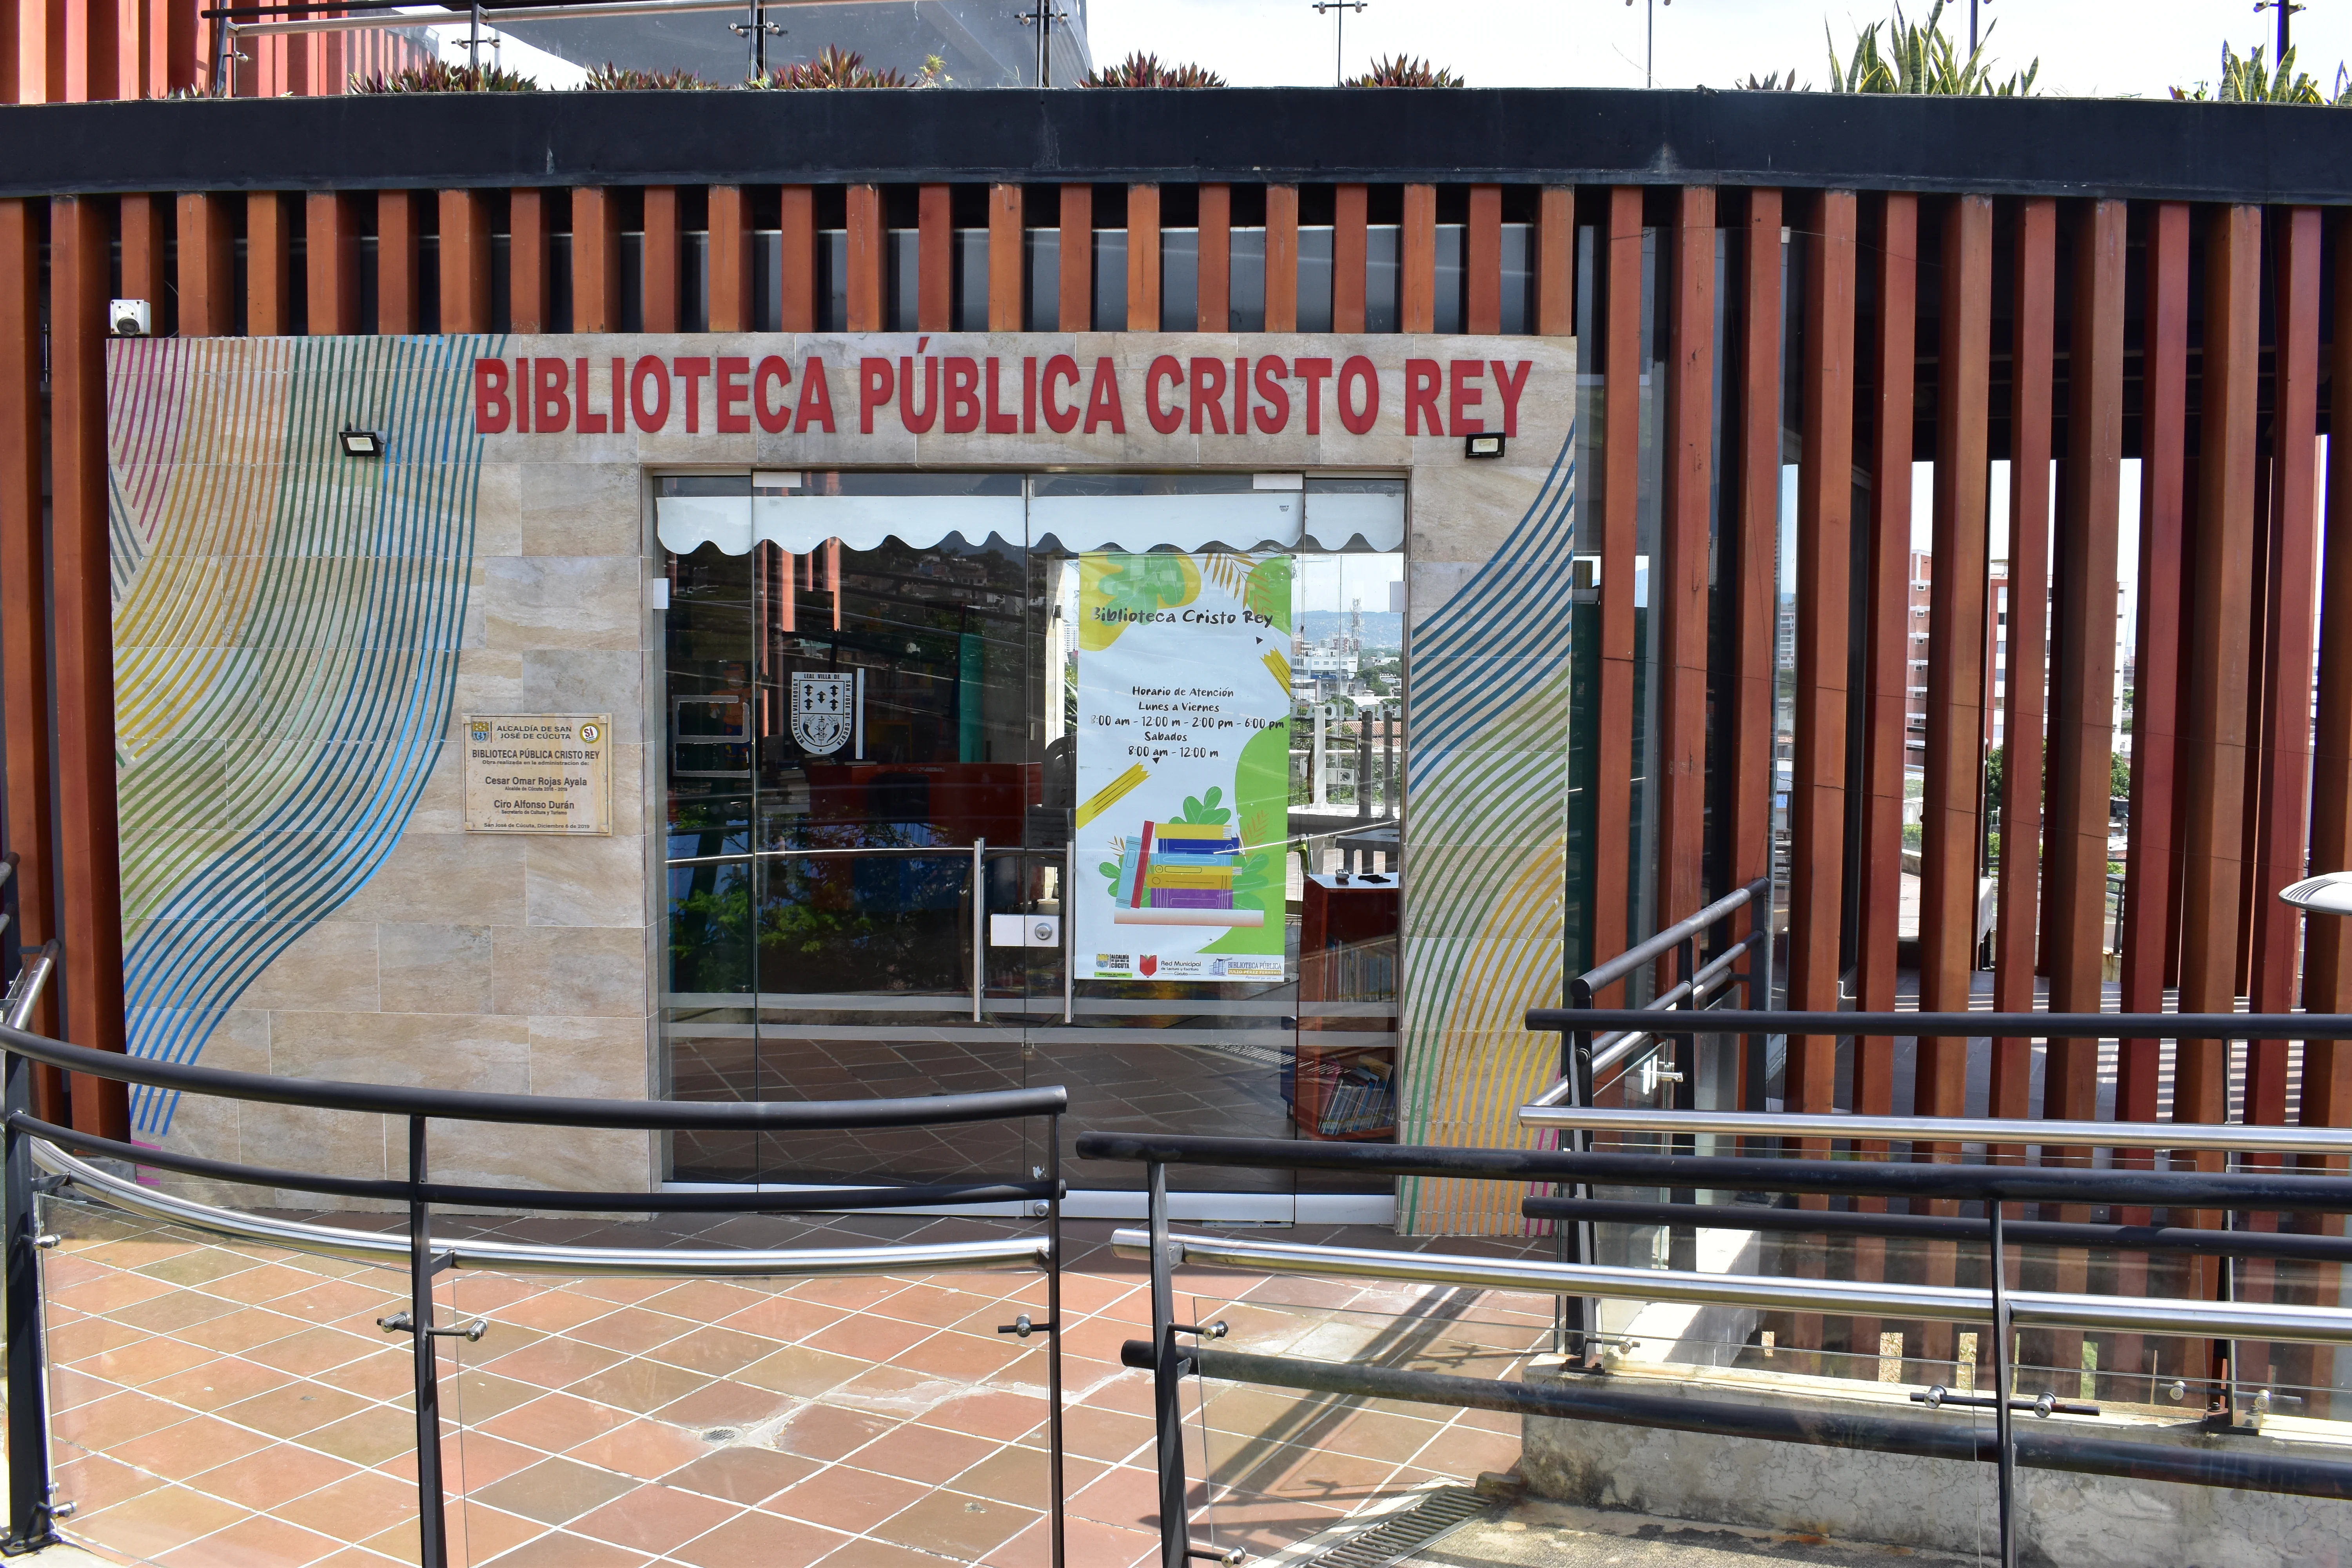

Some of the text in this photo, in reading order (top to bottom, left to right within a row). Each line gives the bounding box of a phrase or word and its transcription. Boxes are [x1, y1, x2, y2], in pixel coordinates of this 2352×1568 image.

[475, 338, 1533, 437] BIBLIOTECA PÚBLICA CRISTO REY
[1091, 607, 1273, 628] Biblioteca Cristo Rey
[1132, 686, 1234, 697] Horario de Atención
[1138, 701, 1169, 711] Lunes
[1181, 702, 1219, 712] Viernes
[1091, 715, 1111, 726] 8:00
[1142, 716, 1168, 727] 12:00
[1192, 717, 1214, 728] 2:00
[1218, 720, 1233, 730] pm
[1245, 718, 1265, 729] 6:00
[1269, 721, 1284, 730] pm
[795, 732, 805, 744] MUY
[837, 723, 850, 746] CUCUTA
[1144, 731, 1187, 742] Sabados
[472, 748, 600, 759] BIBLIOTECA PÚBLICA CRISTO REY
[1128, 746, 1149, 757] 8:00
[1180, 747, 1206, 758] 12:00
[485, 776, 510, 784] Cesar
[538, 777, 561, 787] Rojas
[564, 777, 587, 788] Ayala
[494, 800, 574, 809] Ciro Alfonso Durán
[1259, 961, 1281, 969] PÚBLICA
